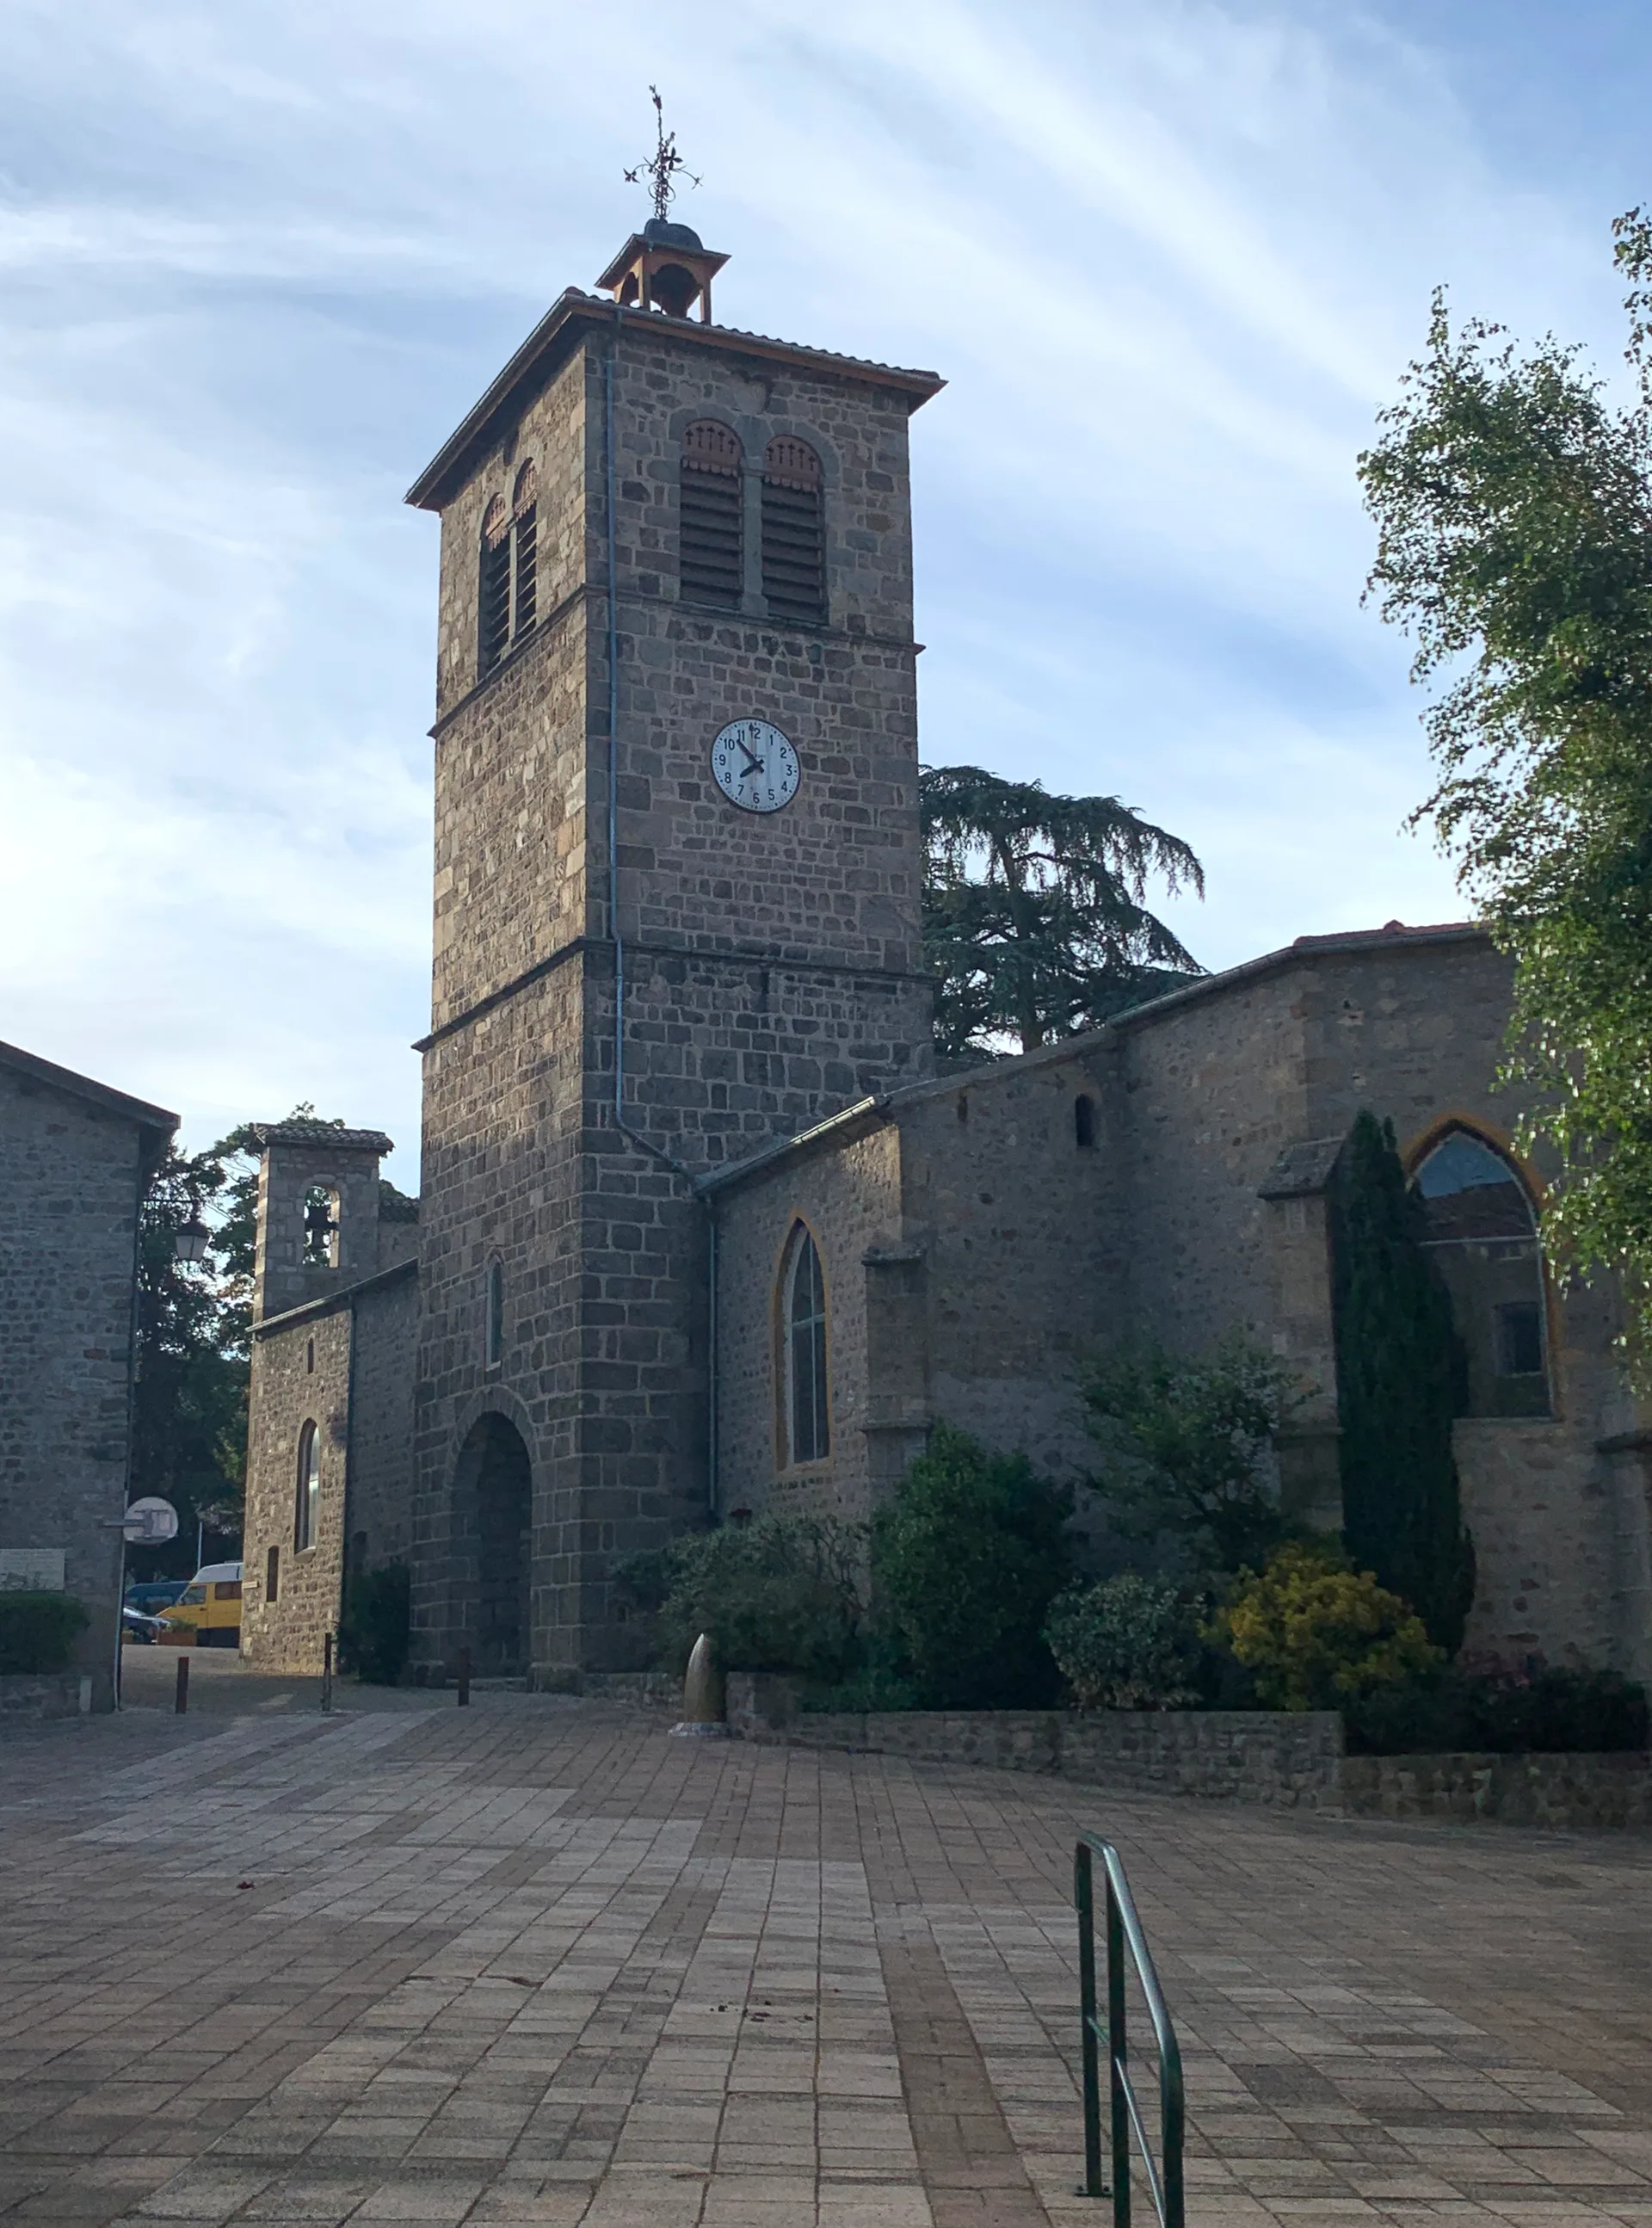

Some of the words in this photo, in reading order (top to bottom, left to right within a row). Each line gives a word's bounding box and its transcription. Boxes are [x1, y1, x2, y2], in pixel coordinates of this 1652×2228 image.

[737, 730, 745, 741] 11
[769, 734, 774, 746] 1
[724, 738, 735, 750] 10
[780, 747, 787, 759] 2
[718, 754, 726, 766] 9
[786, 764, 792, 776] 3
[724, 772, 731, 784] 8
[737, 784, 744, 796] 7
[781, 781, 788, 793] 4
[753, 793, 760, 804] 6
[768, 789, 775, 800] 5
